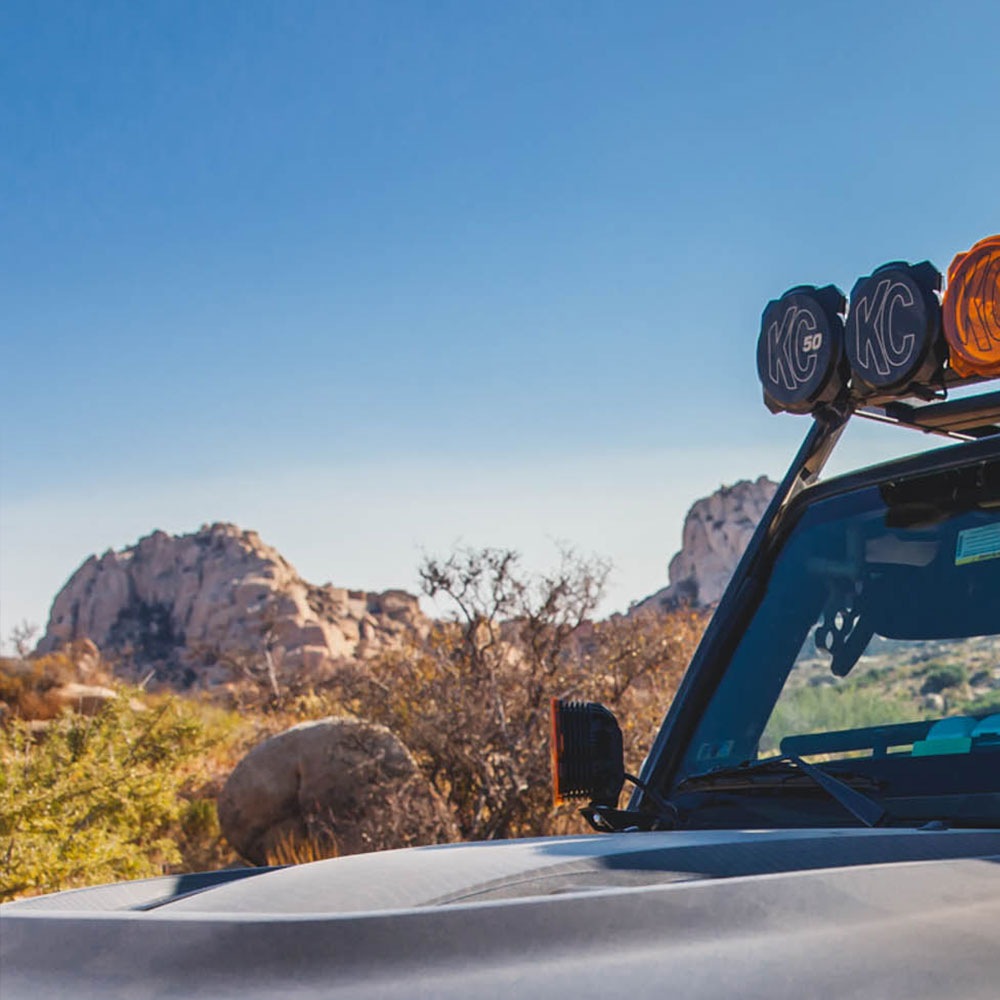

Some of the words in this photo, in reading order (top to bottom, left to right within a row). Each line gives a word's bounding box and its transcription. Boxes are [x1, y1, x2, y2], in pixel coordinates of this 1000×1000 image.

[768, 306, 817, 390] KC
[802, 332, 823, 352] 50
[856, 279, 915, 375] KC
